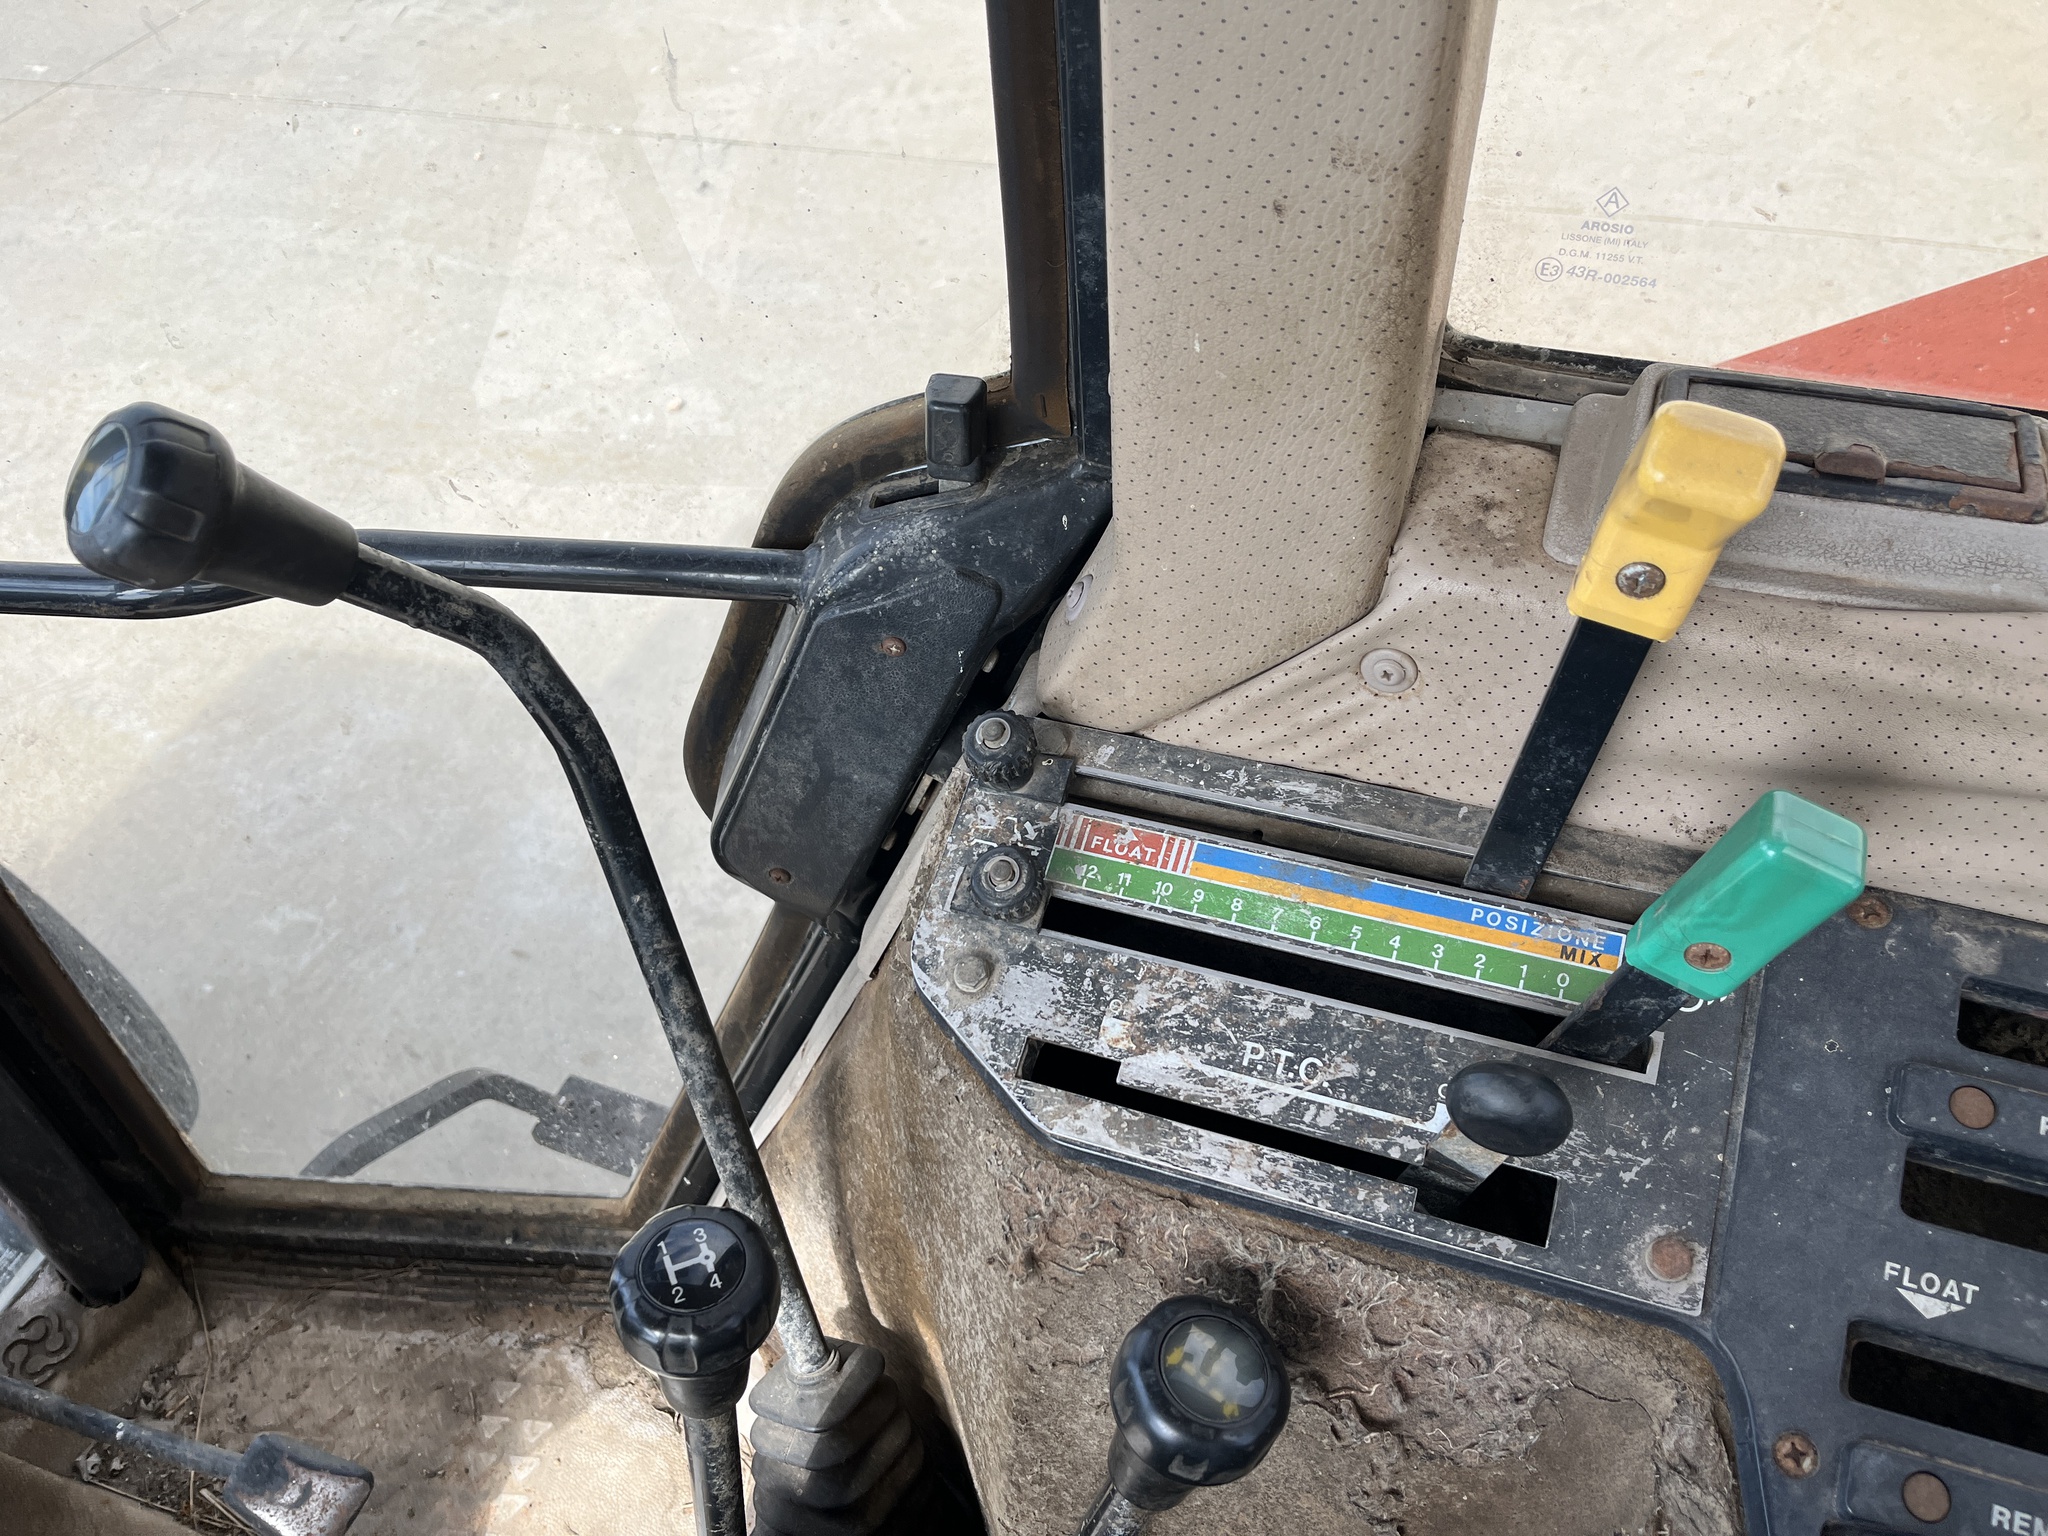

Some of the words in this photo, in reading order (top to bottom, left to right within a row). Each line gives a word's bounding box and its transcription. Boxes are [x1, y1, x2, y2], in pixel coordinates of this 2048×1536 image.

[1581, 220, 1635, 235] AROSIO
[1561, 232, 1602, 245] LISSONE
[1604, 237, 1621, 247] (MI)
[1623, 239, 1649, 249] ITALY
[1558, 248, 1592, 260] D.G.M.
[1596, 252, 1625, 263] 11255
[1628, 255, 1644, 265] V.T.
[1540, 262, 1561, 277] E3
[1566, 265, 1657, 289] 43R-002564
[1091, 835, 1157, 863] FLOAT
[1080, 864, 1098, 879] 12
[1118, 872, 1132, 886] 11
[1155, 881, 1174, 897] 10
[1193, 888, 1205, 902] 9
[1231, 898, 1242, 912] 8
[1273, 908, 1285, 922] 7
[1309, 915, 1323, 930] 6
[1350, 925, 1363, 940] 5
[1388, 934, 1401, 950] 4
[1431, 943, 1445, 958] 3
[1474, 953, 1487, 969] 2
[1519, 964, 1529, 979] 1
[1556, 972, 1570, 988] 0
[1559, 945, 1603, 968] MIX
[693, 1227, 708, 1243] 3
[657, 1240, 668, 1255] 1
[709, 1273, 723, 1289] 4
[1883, 1260, 1980, 1305] FLOAT
[671, 1286, 687, 1304] 2
